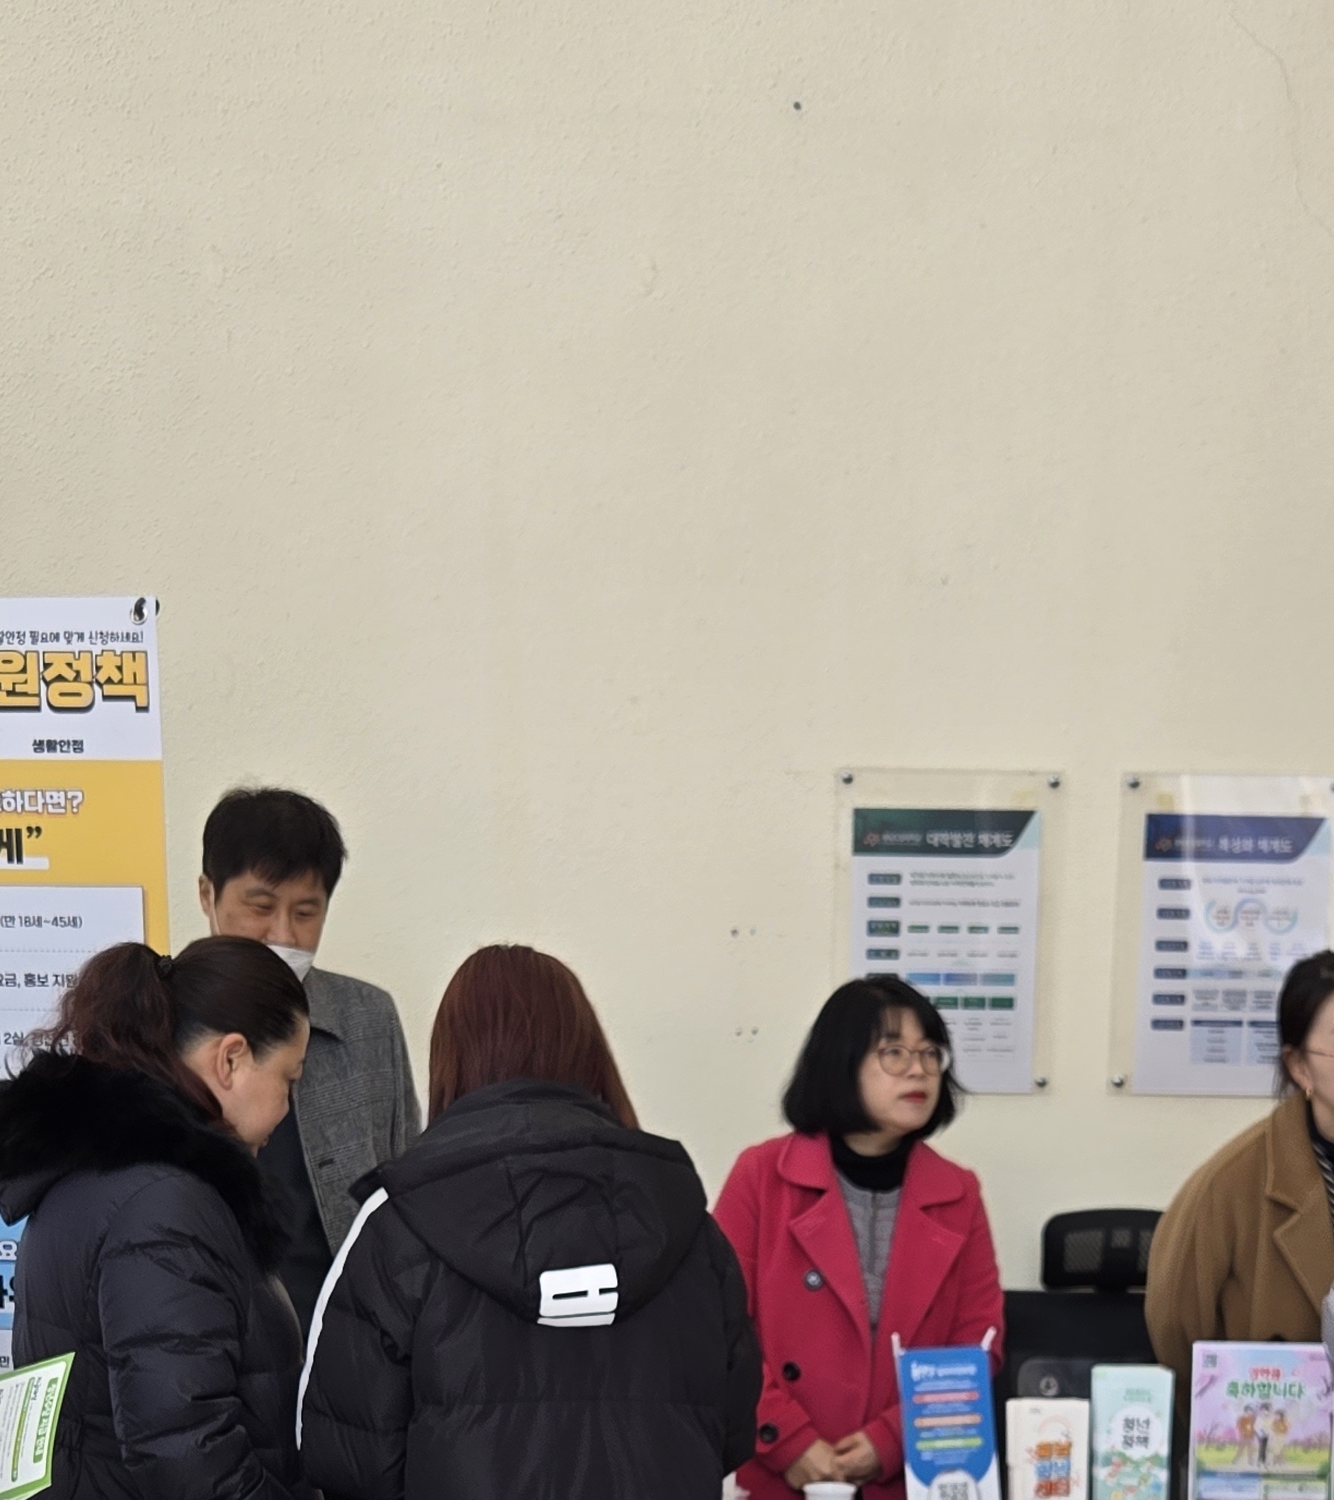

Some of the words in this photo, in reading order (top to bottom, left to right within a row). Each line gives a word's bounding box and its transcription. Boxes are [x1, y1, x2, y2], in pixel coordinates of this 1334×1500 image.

[88, 631, 144, 644] 신청하세요!
[32, 739, 84, 754] 생활안정
[24, 974, 48, 988] 홍보
